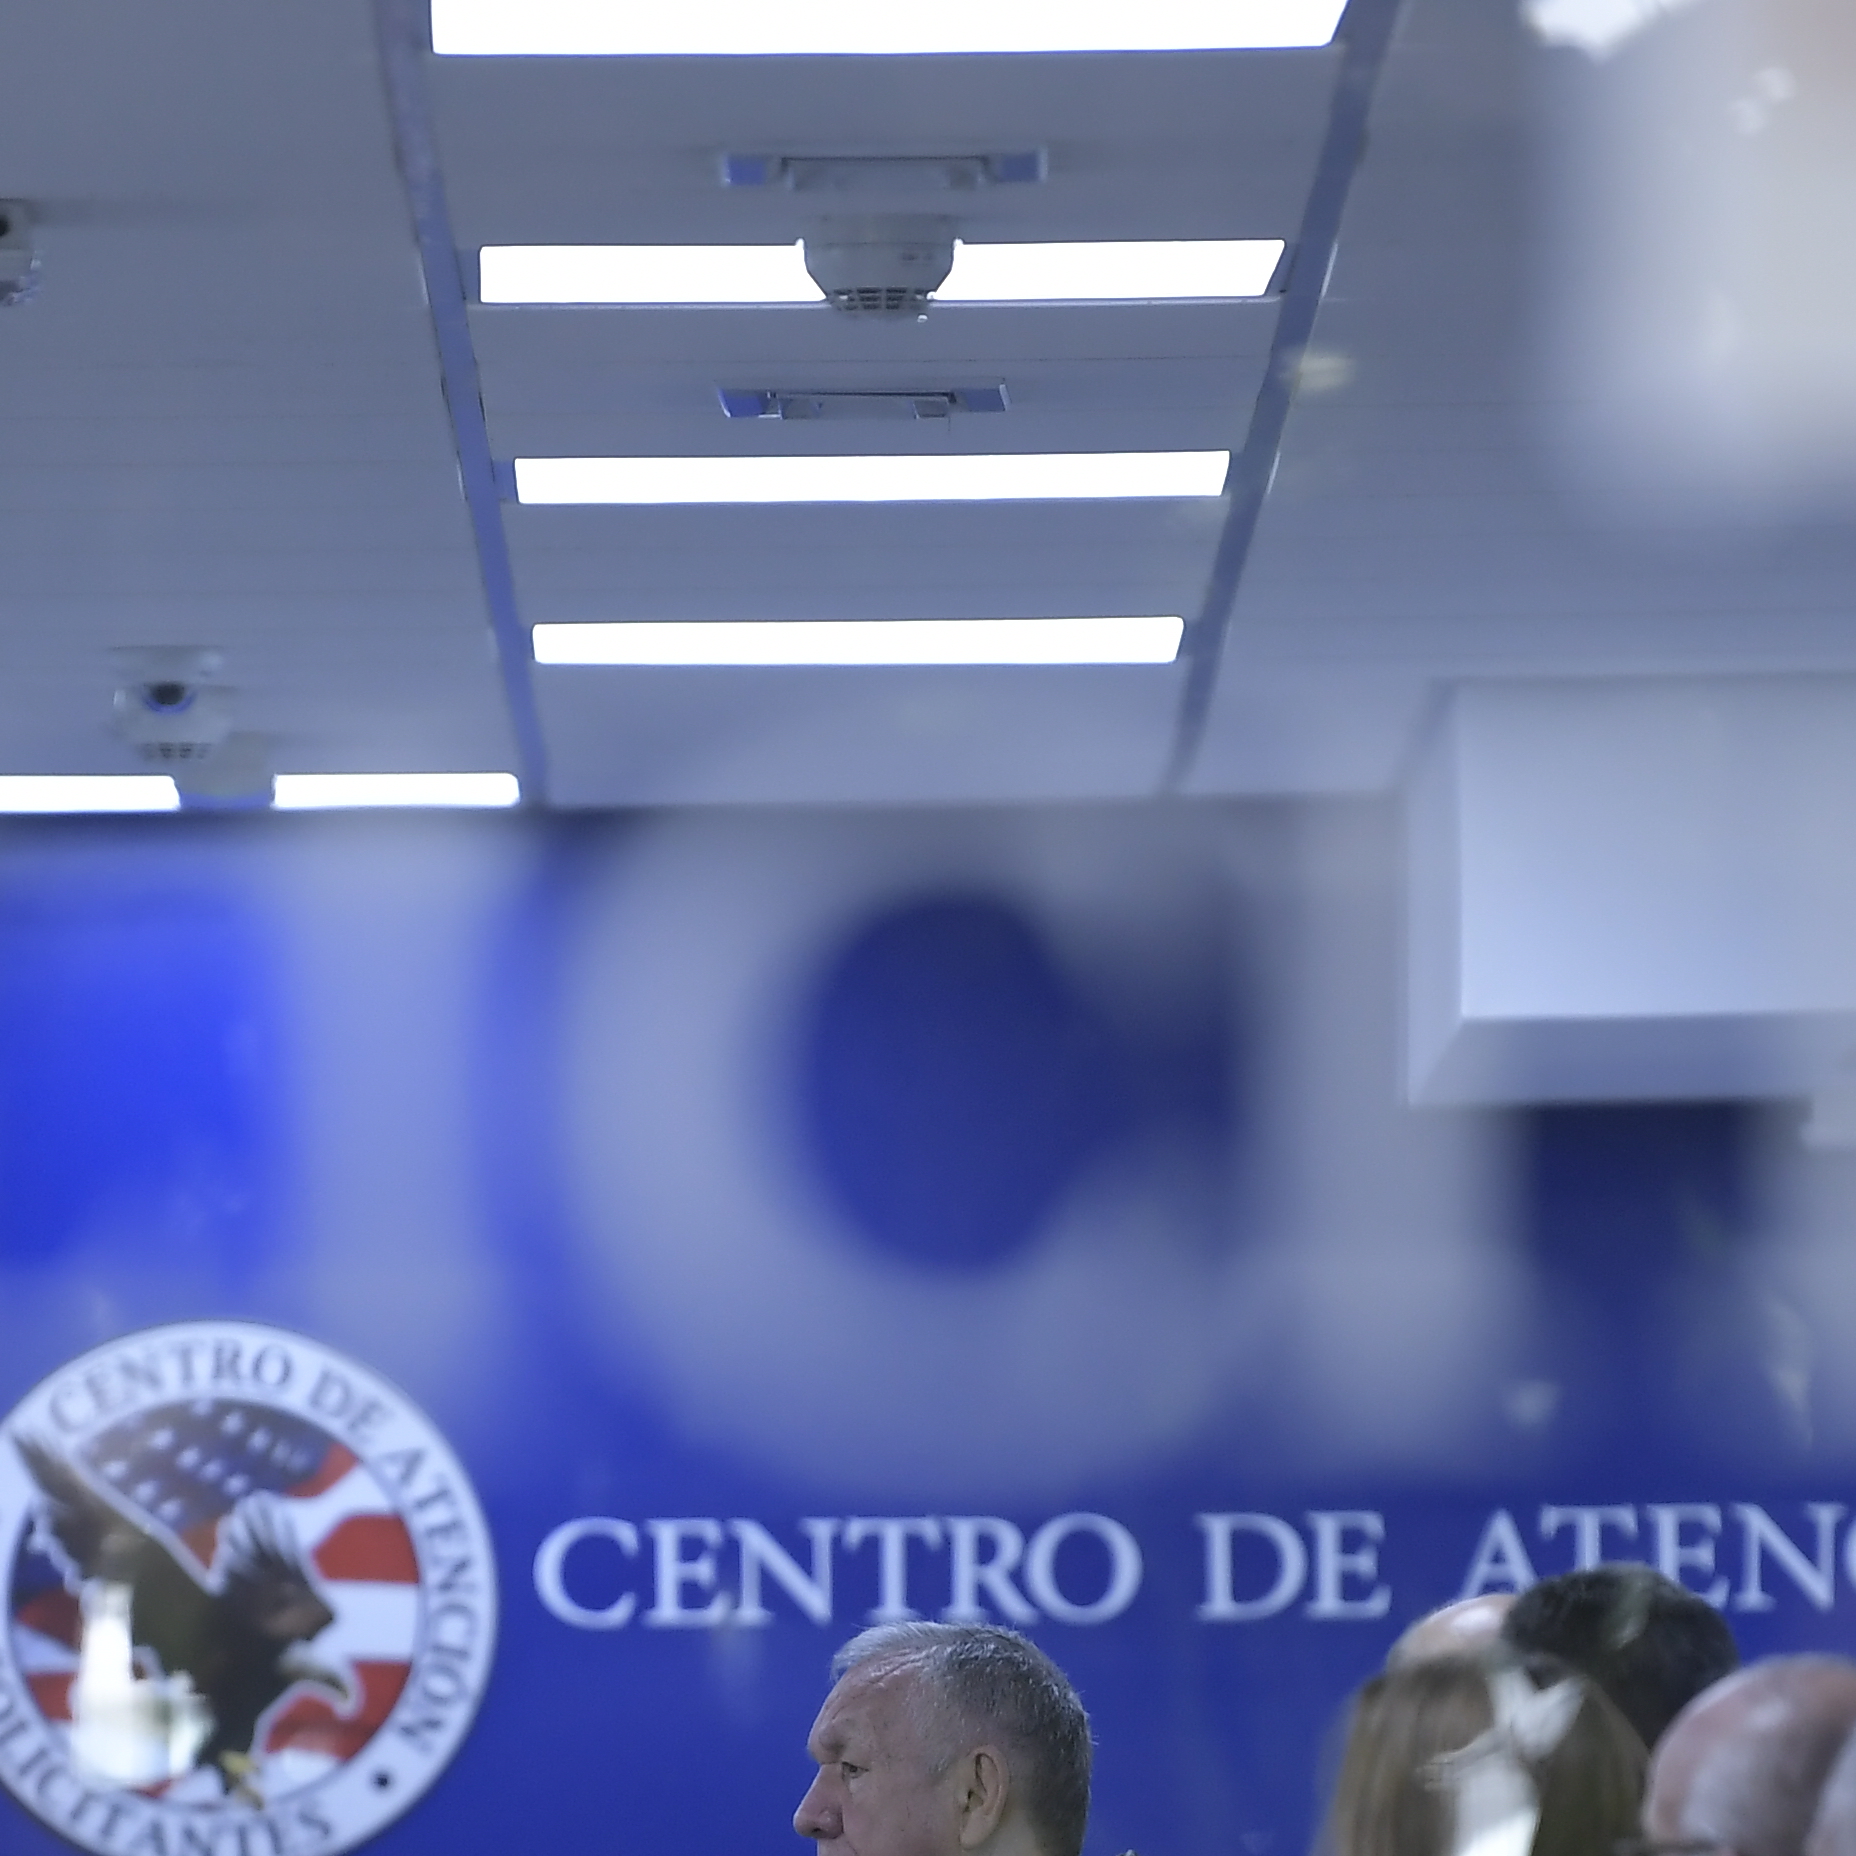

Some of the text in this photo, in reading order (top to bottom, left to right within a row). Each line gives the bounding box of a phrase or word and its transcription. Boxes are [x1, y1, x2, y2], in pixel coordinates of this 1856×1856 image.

[47, 1338, 293, 1437] CENTRO
[307, 1368, 395, 1447] DE
[532, 1510, 1143, 1632] CENTRO
[1195, 1509, 1394, 1624] DE
